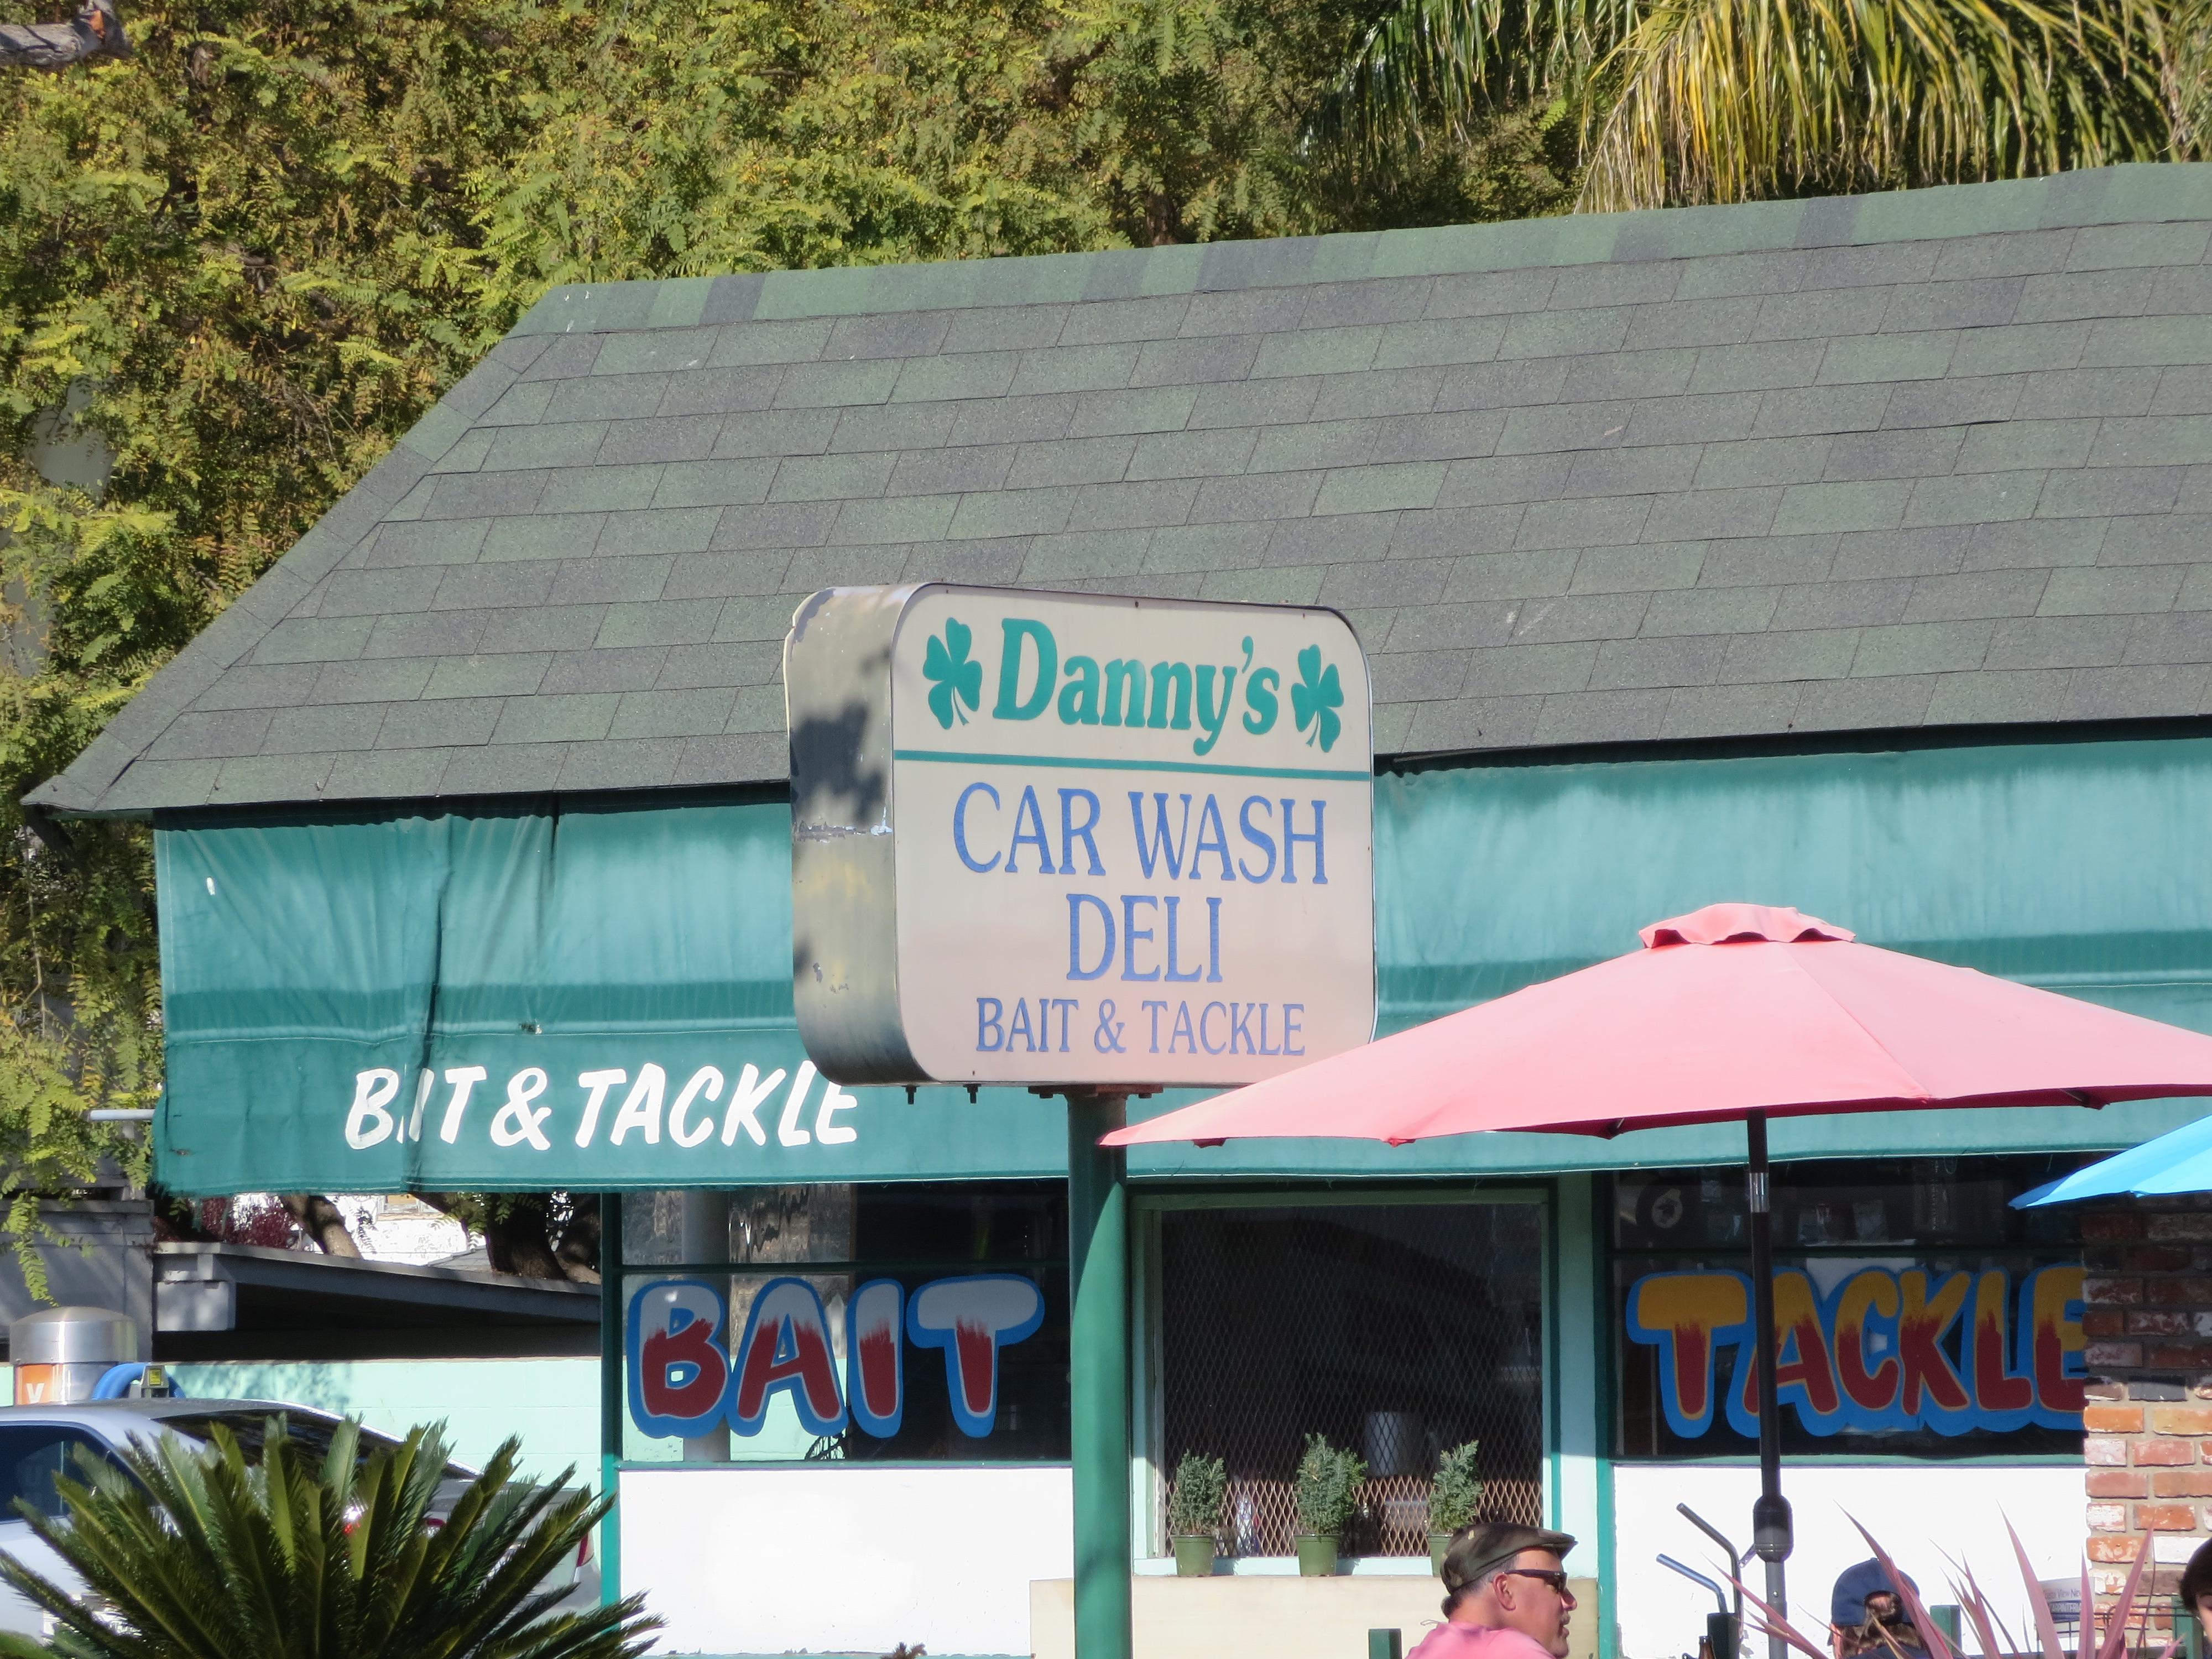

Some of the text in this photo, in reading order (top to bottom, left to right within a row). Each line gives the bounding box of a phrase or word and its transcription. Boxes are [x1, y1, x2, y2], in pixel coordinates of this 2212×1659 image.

[993, 618, 1280, 756] Danny's
[953, 781, 1328, 885] CAR WASH
[1066, 893, 1223, 983] DELI
[976, 997, 1306, 1056] BAIT & TACKLE
[344, 1058, 859, 1151] BIT & TACKLE
[626, 1273, 1045, 1438] BAIT
[1626, 1264, 2086, 1438] TACKLE
